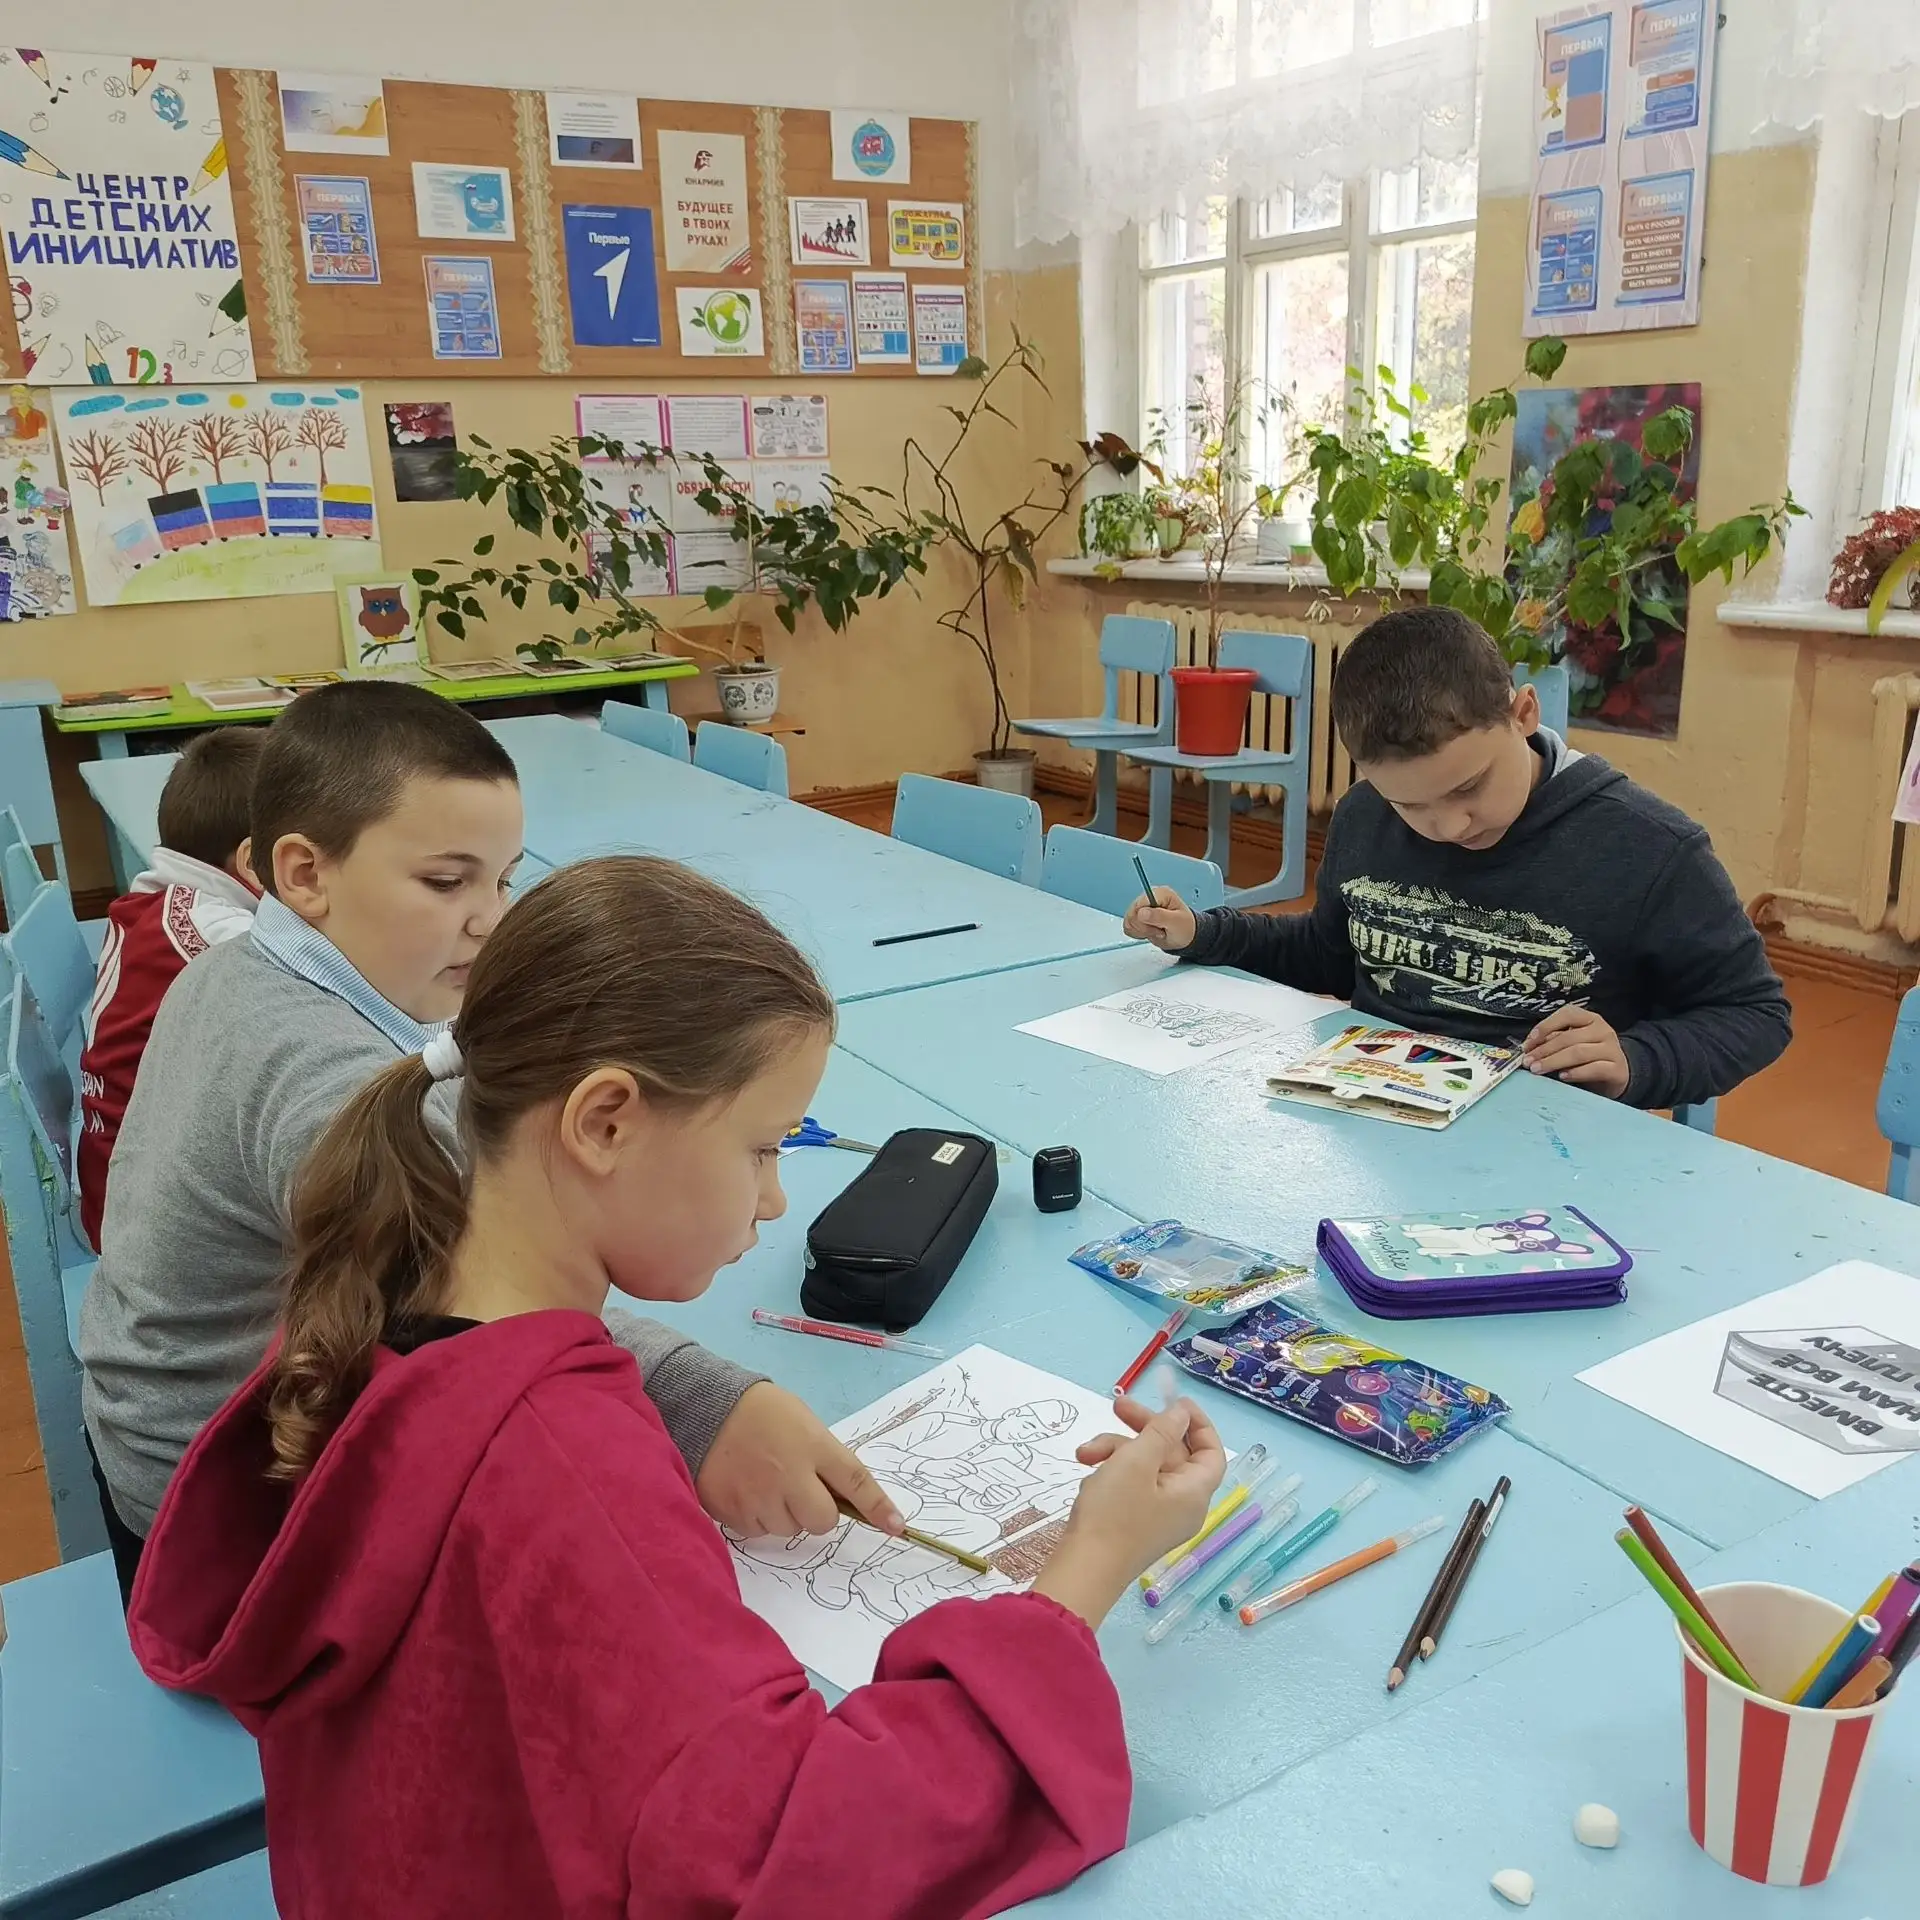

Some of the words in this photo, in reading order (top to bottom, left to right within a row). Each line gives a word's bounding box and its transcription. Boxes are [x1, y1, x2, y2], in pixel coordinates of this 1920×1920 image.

[1650, 11, 1698, 33] ПЕРВЫХ
[1561, 35, 1604, 56] ПЕРВЫХ
[76, 172, 189, 201] ЦЕНТР
[677, 200, 733, 215] БУДУЩЕЕ
[1638, 191, 1685, 208] ПЕРВЫХ
[29, 197, 212, 233] ДЕТСКИХ
[683, 217, 690, 228] В
[693, 218, 731, 230] ТВОИХ
[1553, 205, 1596, 222] ПЕРВЫХ
[588, 231, 631, 247] Первые
[687, 234, 728, 247] РУКАХ!
[8, 230, 239, 270] ИНИЦИАТИВ
[1799, 1336, 1916, 1383] ПЛЕЧУ
[1746, 1372, 1884, 1436] ВМЕСТЕ
[1839, 1380, 1920, 1423] НАМ
